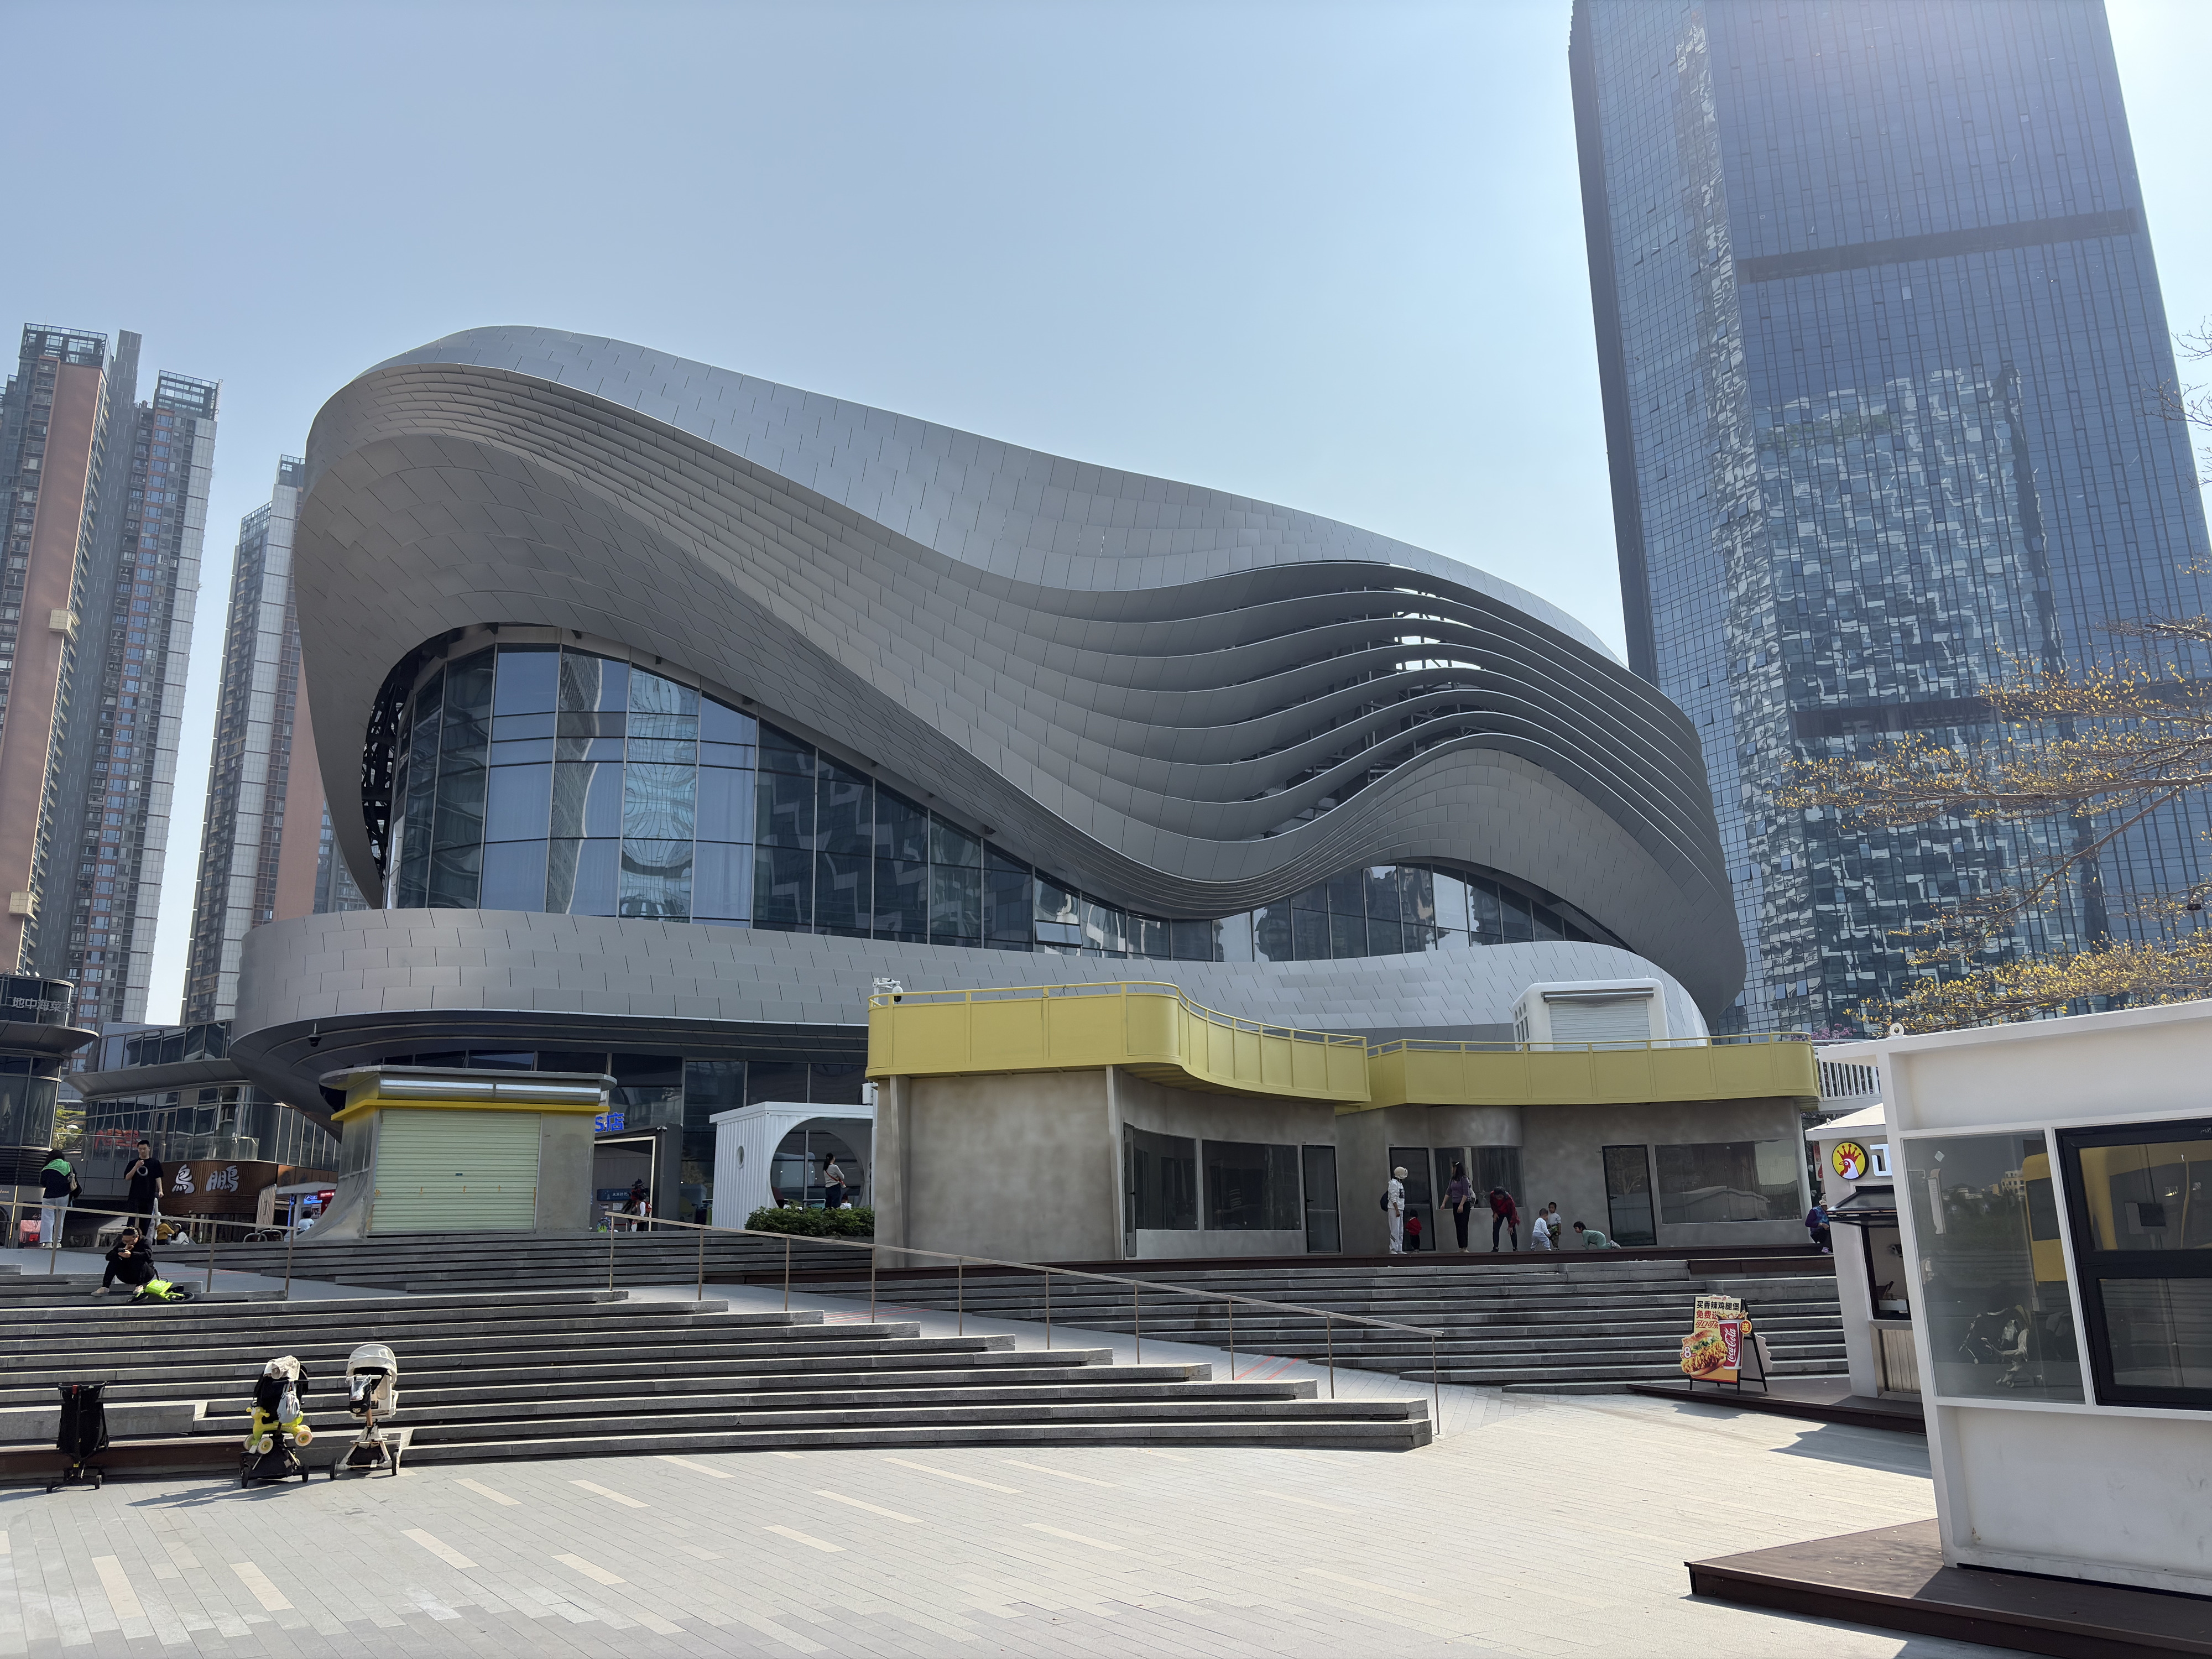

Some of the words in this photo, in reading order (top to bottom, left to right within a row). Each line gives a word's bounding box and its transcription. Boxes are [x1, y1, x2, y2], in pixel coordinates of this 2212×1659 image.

[1697, 1301, 1739, 1311] 买香辣鸡腿堡
[1742, 1322, 1749, 1332] 送
